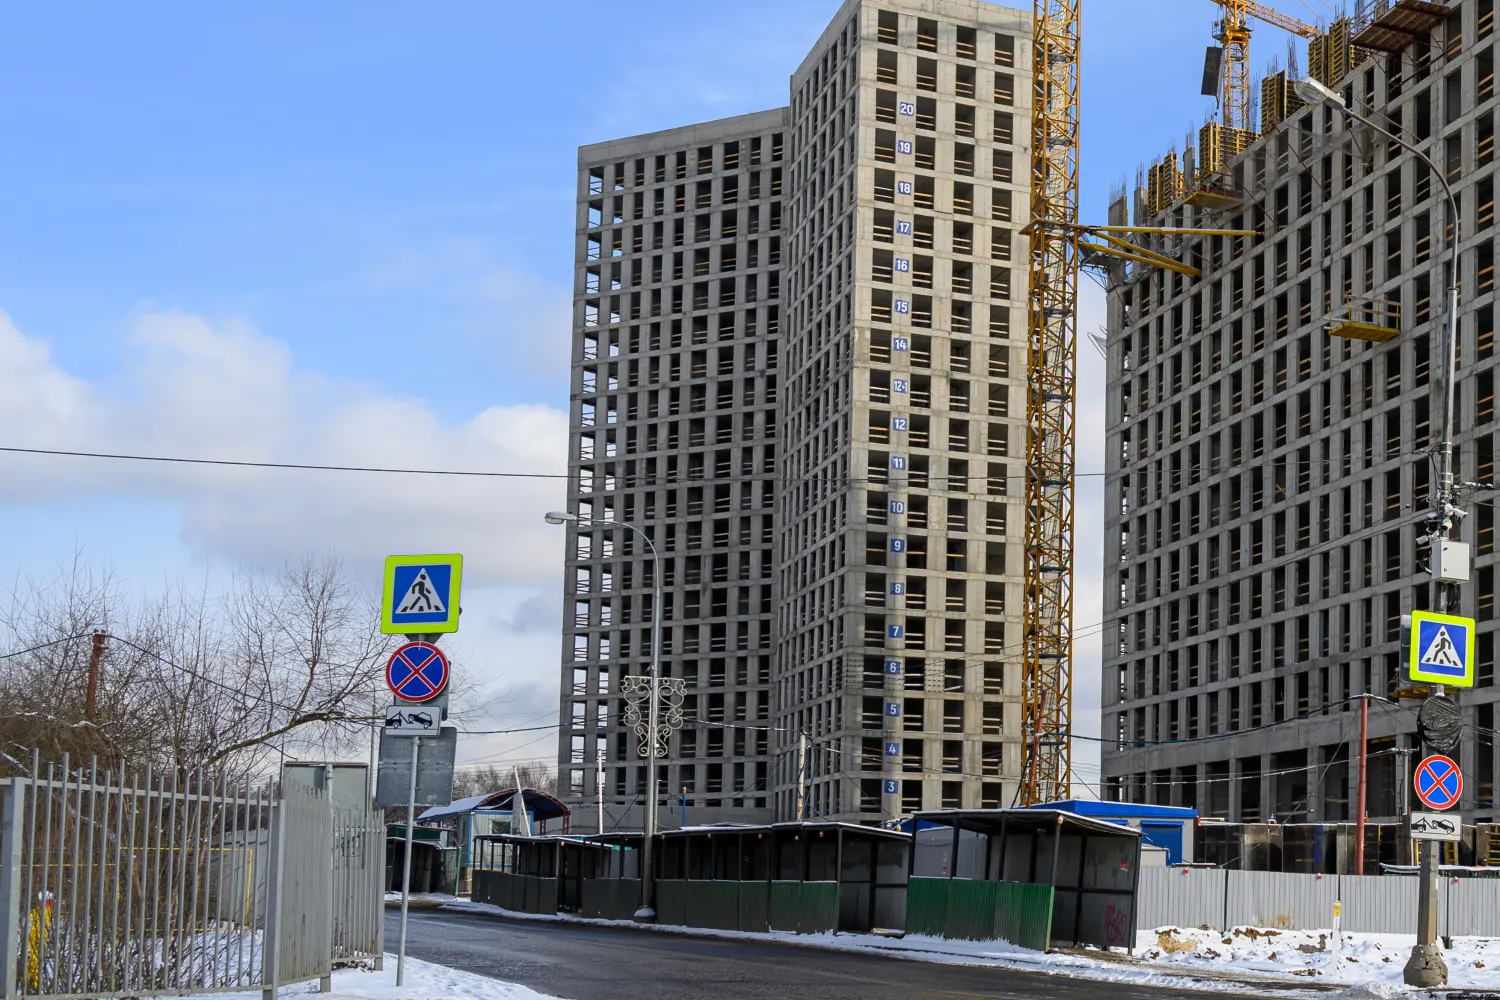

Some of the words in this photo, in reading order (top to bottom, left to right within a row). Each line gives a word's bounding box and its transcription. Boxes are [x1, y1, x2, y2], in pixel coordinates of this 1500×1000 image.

[901, 103, 914, 115] 20
[899, 141, 911, 153] 19
[899, 182, 911, 194] 18
[899, 222, 910, 233] 17
[896, 259, 907, 270] 16
[896, 301, 907, 312] 15
[895, 340, 907, 350] 14
[894, 381, 908, 392] 12+1
[895, 419, 906, 430] 12
[894, 458, 903, 468] 11
[892, 502, 903, 513] 10
[894, 540, 901, 551] 9
[894, 583, 901, 594] 8
[893, 626, 900, 636] 7
[890, 662, 896, 672] 6
[890, 704, 897, 714] 5
[889, 744, 896, 754] 4
[888, 781, 895, 791] 3
